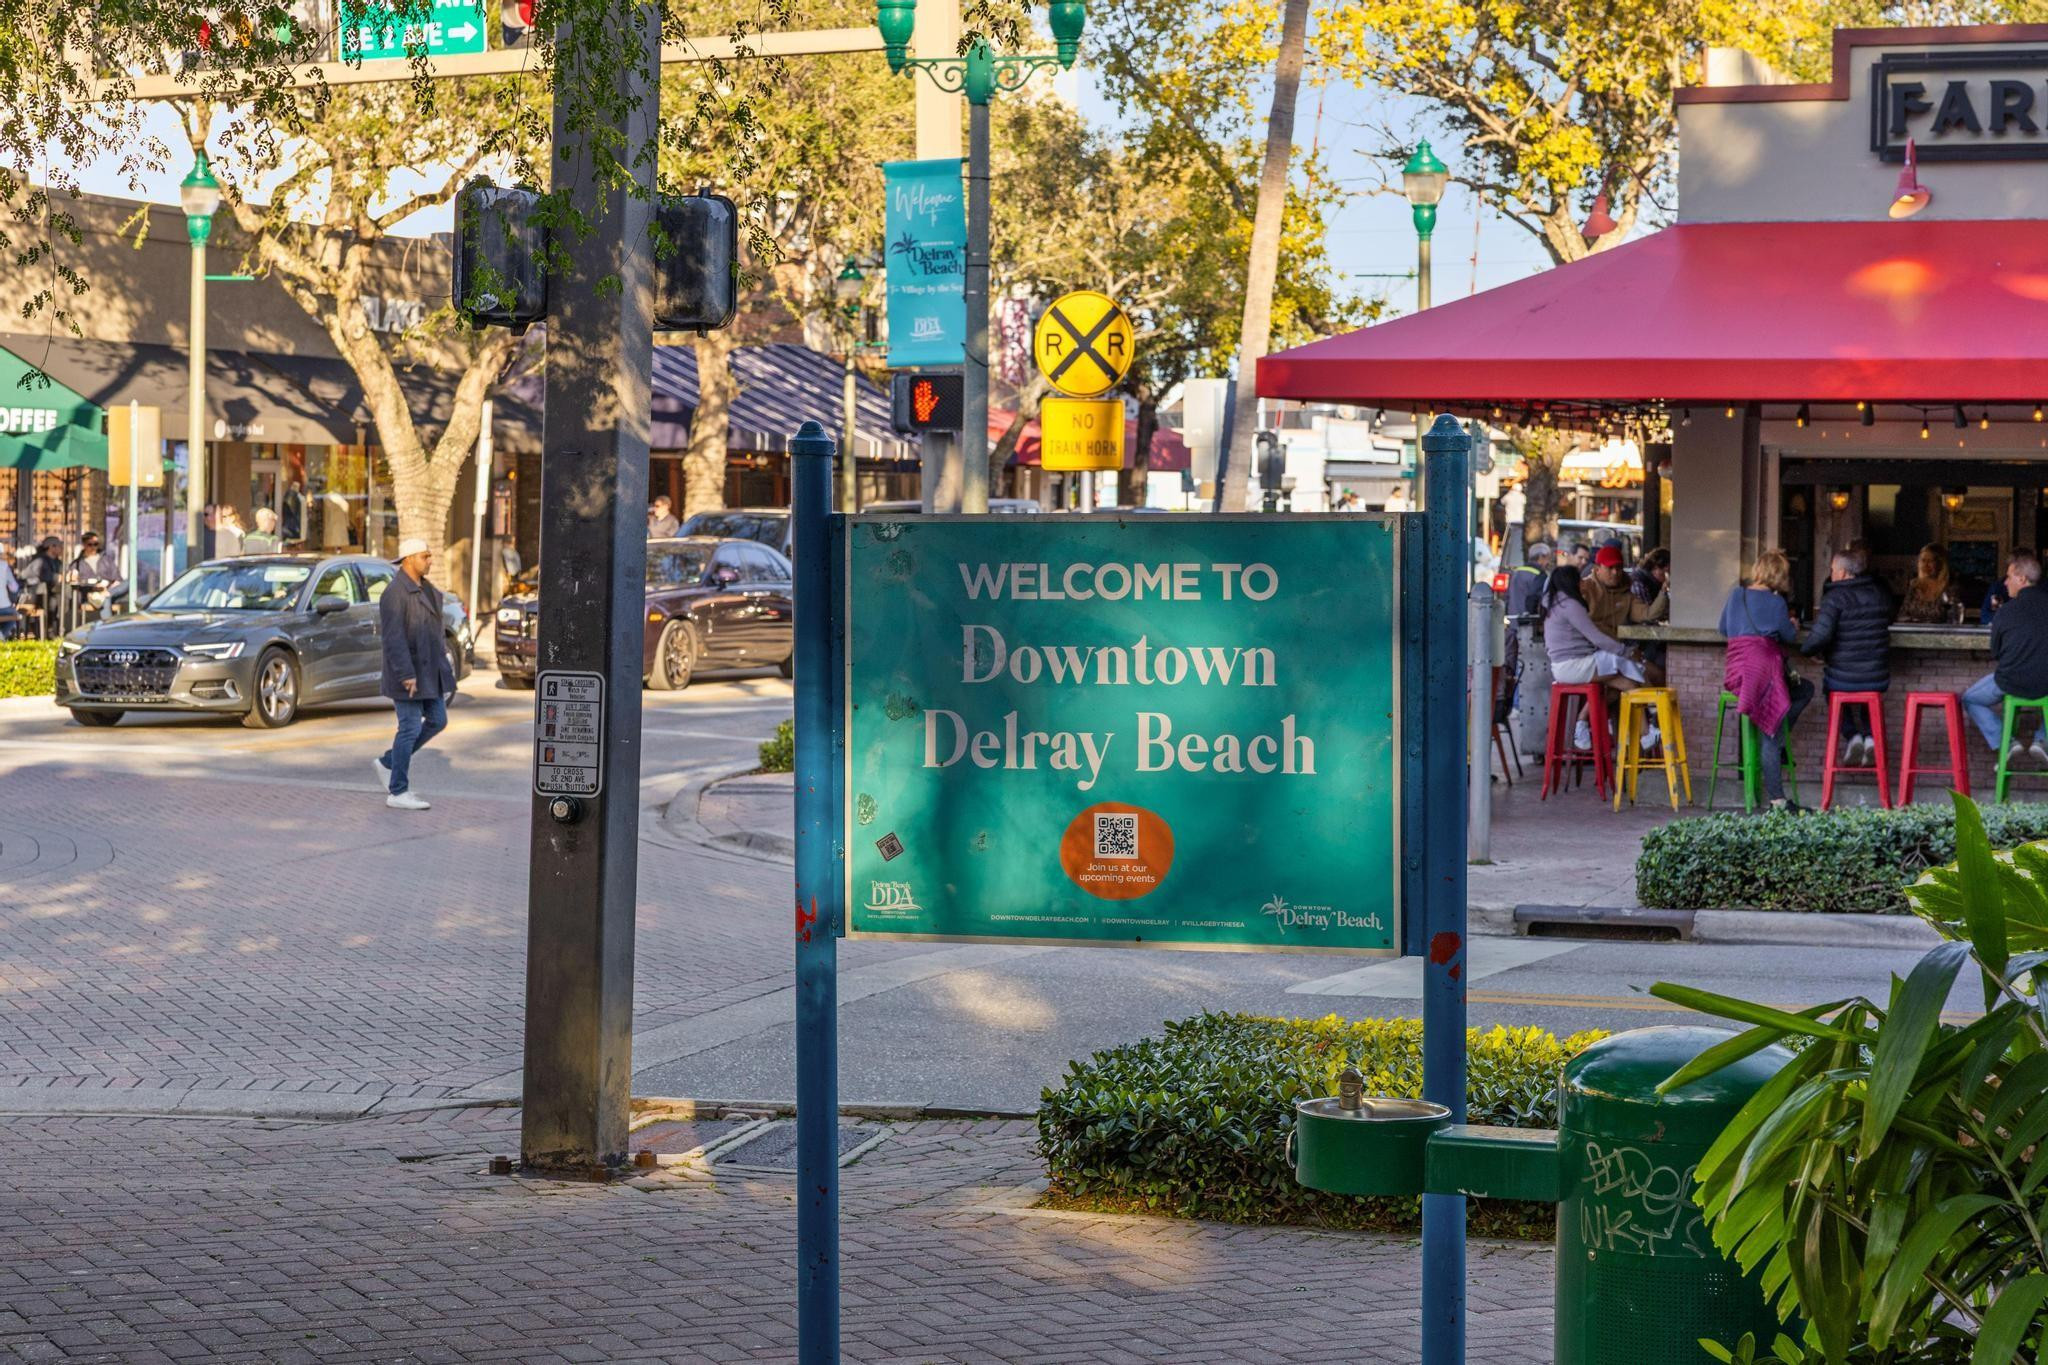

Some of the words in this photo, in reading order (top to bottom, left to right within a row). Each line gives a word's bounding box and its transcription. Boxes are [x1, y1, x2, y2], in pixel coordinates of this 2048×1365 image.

[402, 22, 444, 48] AVE
[1890, 79, 2048, 134] FAR
[896, 184, 957, 220] Welcome
[910, 246, 962, 263] Delray
[917, 258, 966, 275] Beach
[1046, 333, 1062, 356] R
[1108, 333, 1124, 356] R
[0, 407, 57, 432] OFFEE
[1072, 413, 1094, 429] NO
[1050, 439, 1081, 455] TRAIN
[1086, 440, 1117, 456] HORN
[958, 562, 1202, 600] WELCOME
[1211, 562, 1279, 601] TO
[960, 624, 1278, 686] Downtown
[922, 709, 1115, 791] Delray
[1135, 712, 1317, 775] Beach
[560, 775, 573, 783] 2ND
[565, 783, 590, 791] BUTTON
[1087, 863, 1106, 871] Join
[1121, 864, 1130, 872] at
[1079, 873, 1124, 883] upcoming
[1126, 875, 1156, 883] events
[872, 887, 914, 905] DDA
[1281, 908, 1336, 931] Delray
[1337, 911, 1384, 930] Beach
